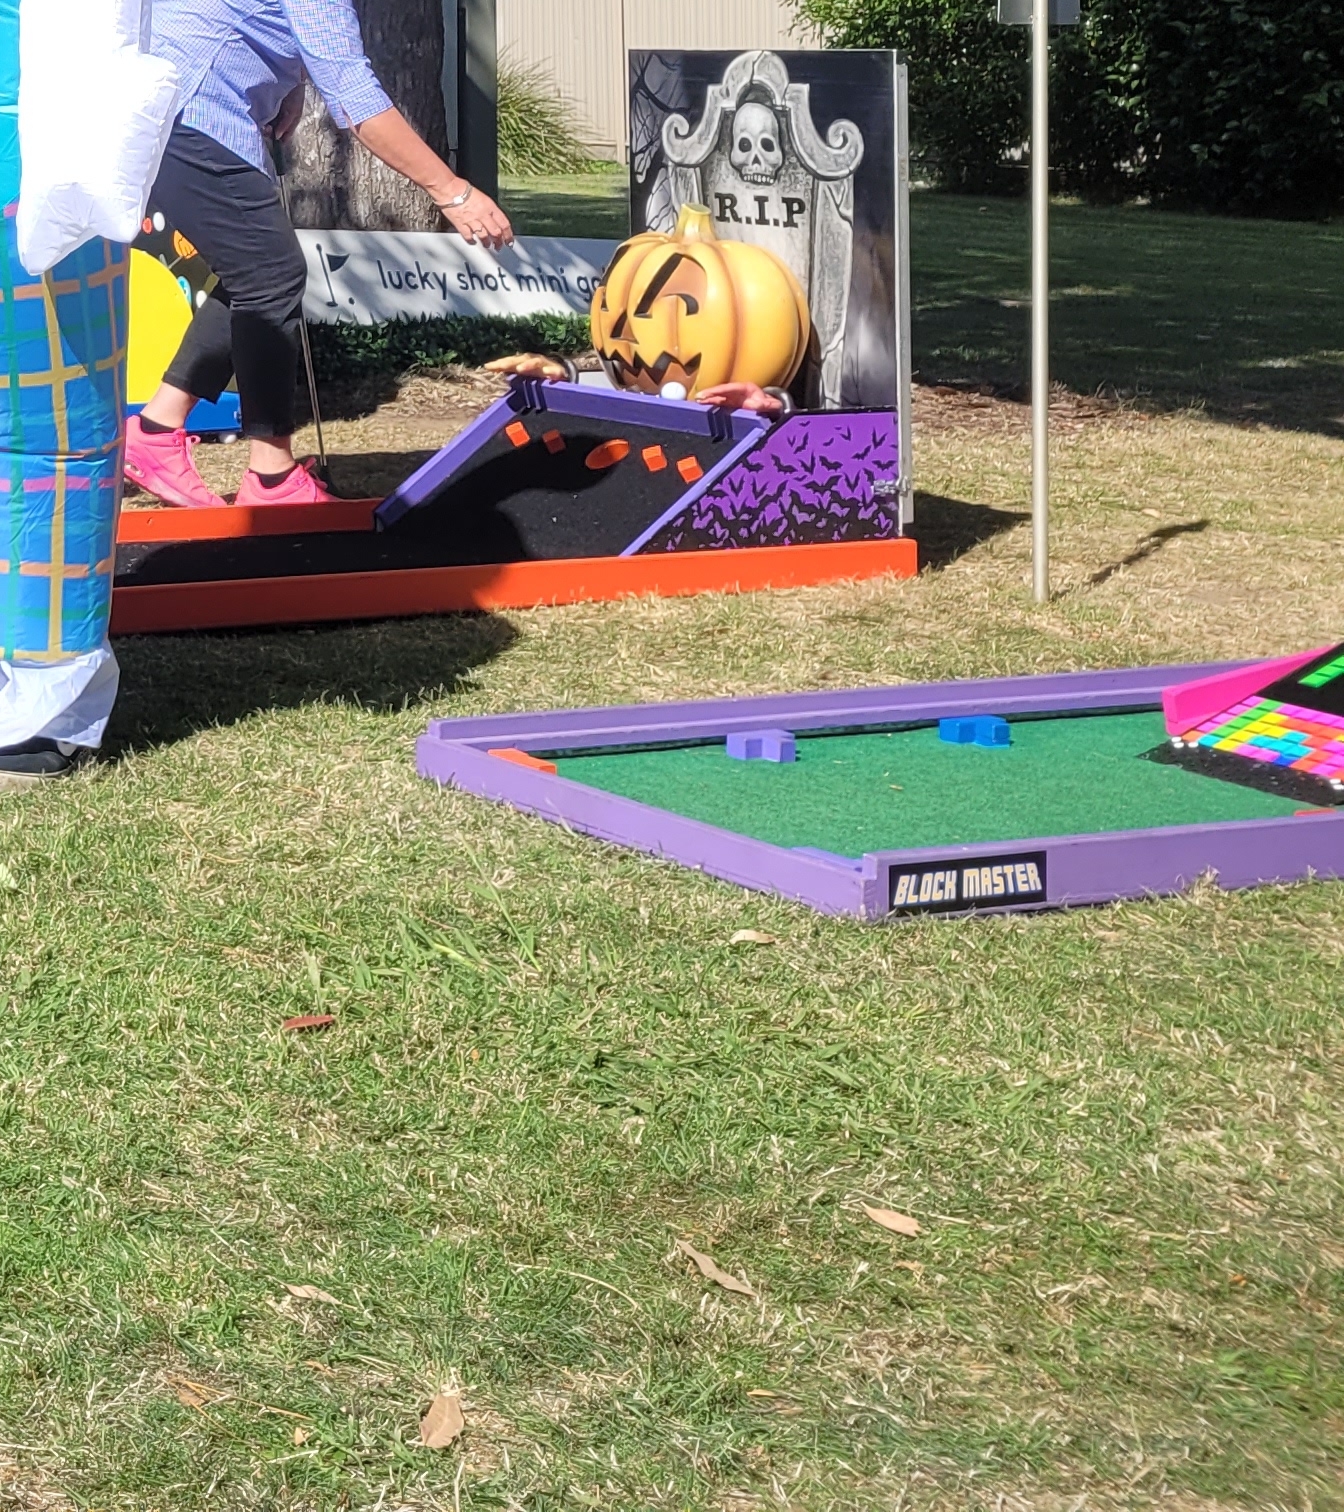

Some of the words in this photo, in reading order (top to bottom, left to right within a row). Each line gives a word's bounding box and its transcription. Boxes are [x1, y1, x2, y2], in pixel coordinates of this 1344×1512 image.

[377, 260, 447, 300] lucky
[456, 262, 511, 291] shot
[516, 267, 570, 293] mini
[577, 266, 605, 303] go
[892, 868, 959, 907] BLOCK
[961, 862, 1044, 900] MASTER
